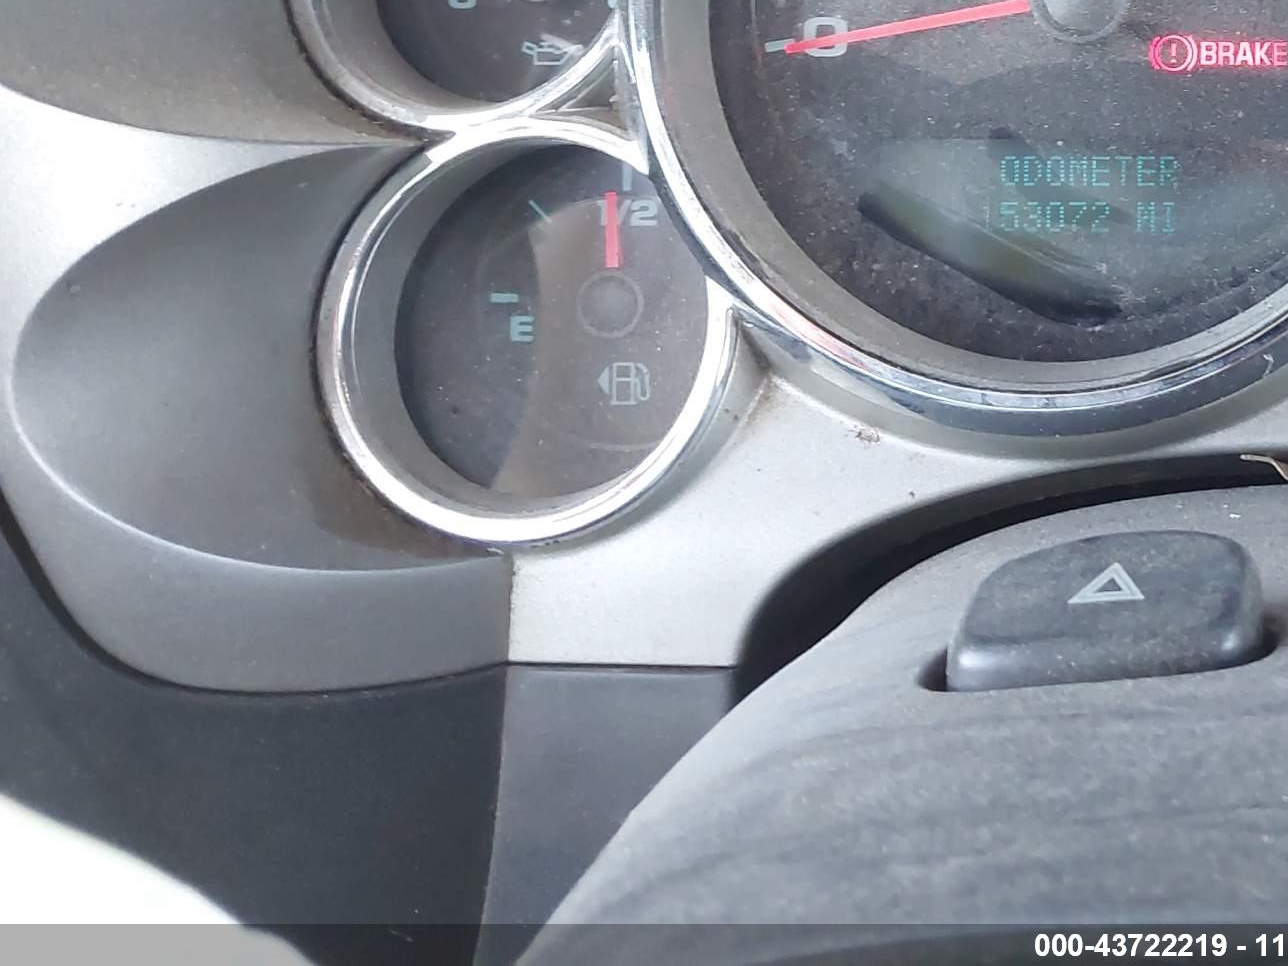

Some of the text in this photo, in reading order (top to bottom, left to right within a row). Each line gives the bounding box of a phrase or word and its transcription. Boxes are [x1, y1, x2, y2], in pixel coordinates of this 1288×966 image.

[803, 16, 849, 58] 0
[1200, 40, 1288, 66] BRAKE
[1000, 155, 1179, 187] ODOMETER
[1136, 201, 1176, 234] MI
[510, 316, 534, 342] E
